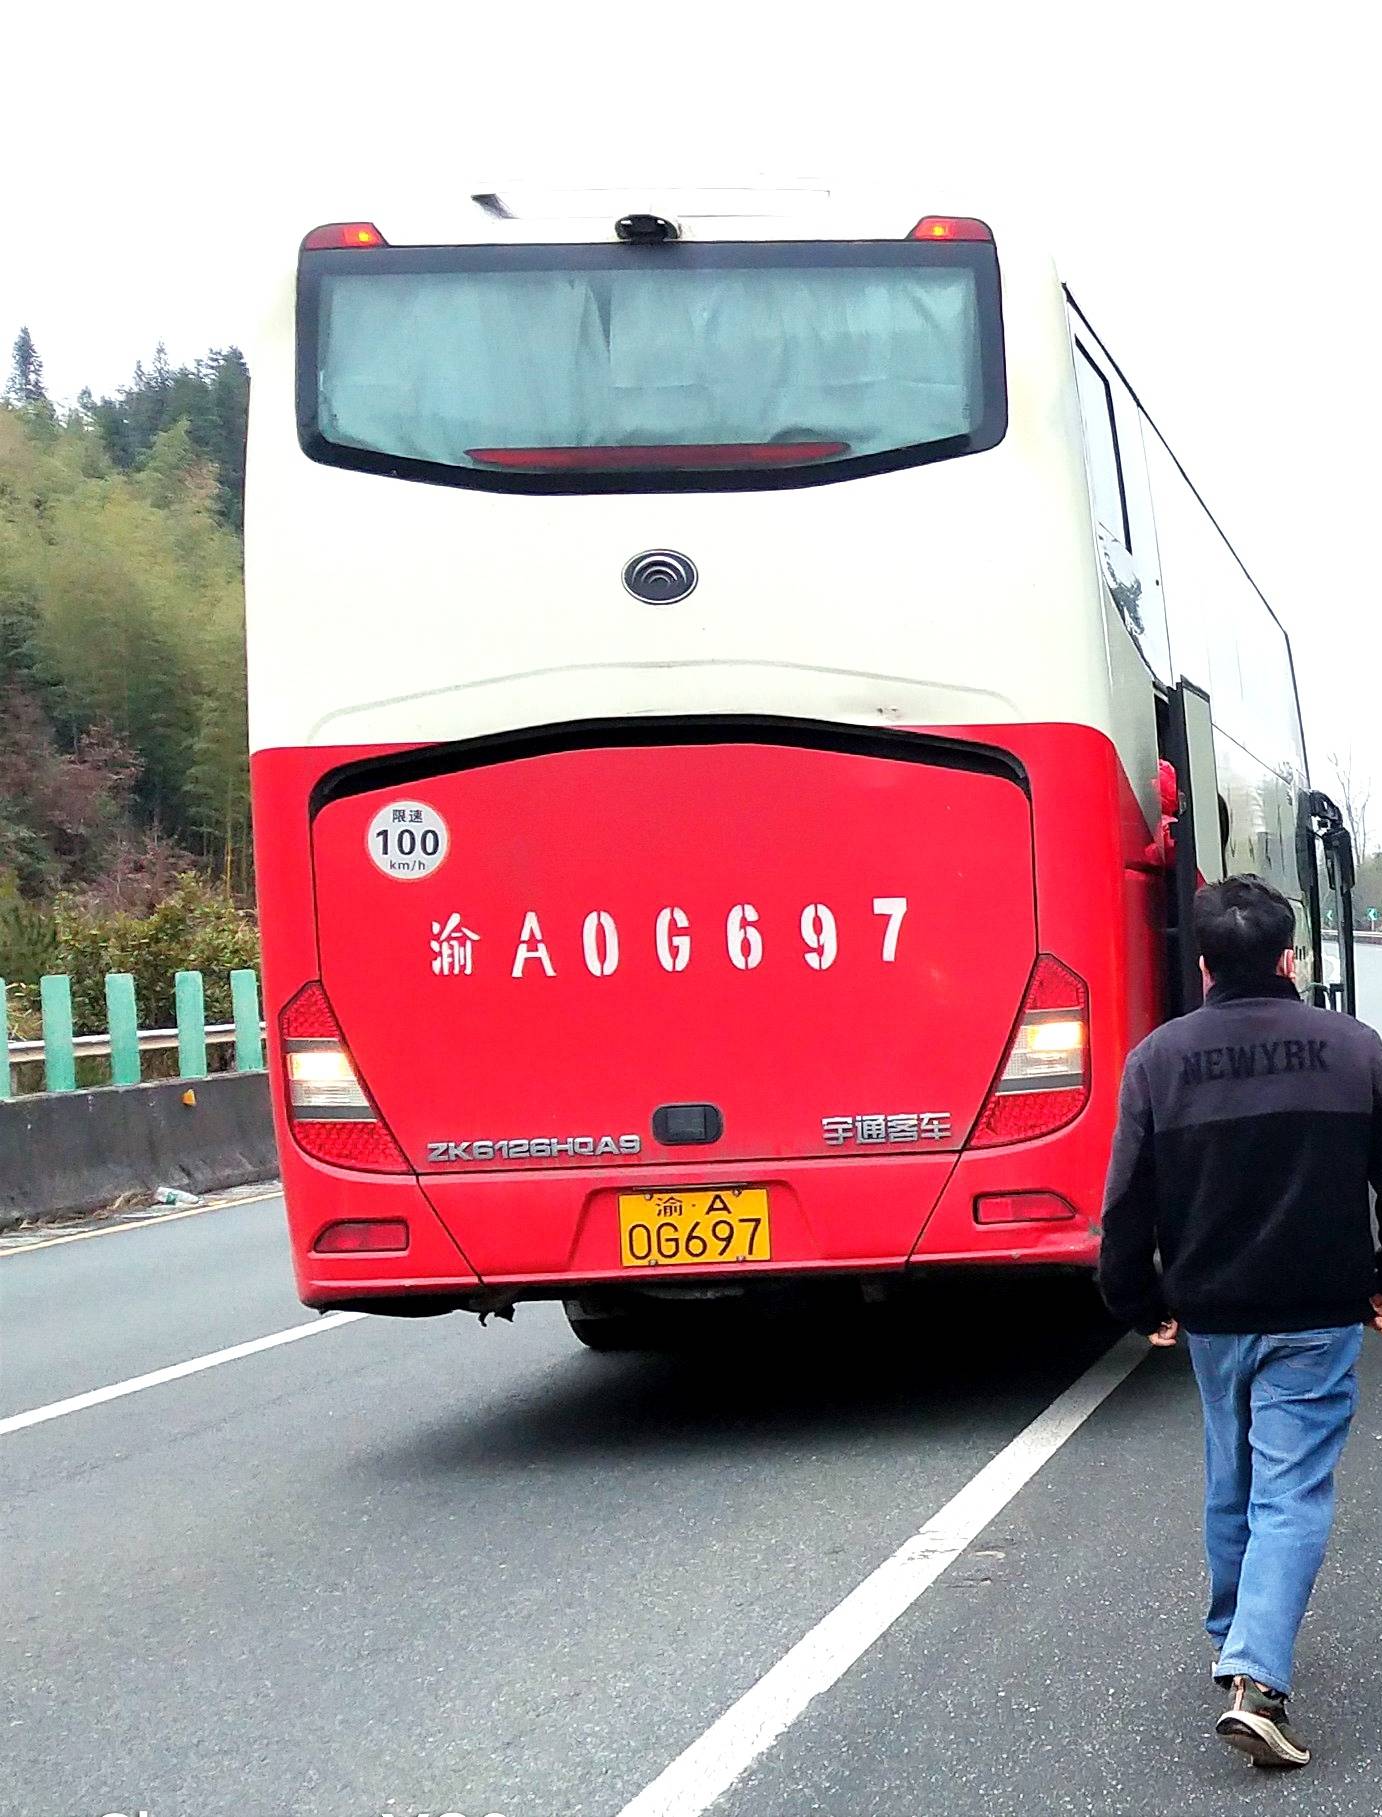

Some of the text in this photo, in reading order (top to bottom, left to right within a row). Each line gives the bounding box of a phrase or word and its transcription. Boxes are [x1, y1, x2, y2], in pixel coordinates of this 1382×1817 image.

[391, 809, 424, 824] 限速
[375, 828, 440, 856] 100
[388, 859, 427, 872] km/h
[821, 1112, 952, 1145] 宇通客车
[426, 1134, 641, 1162] ZK6126HQA9
[628, 1217, 762, 1260] 0G697
